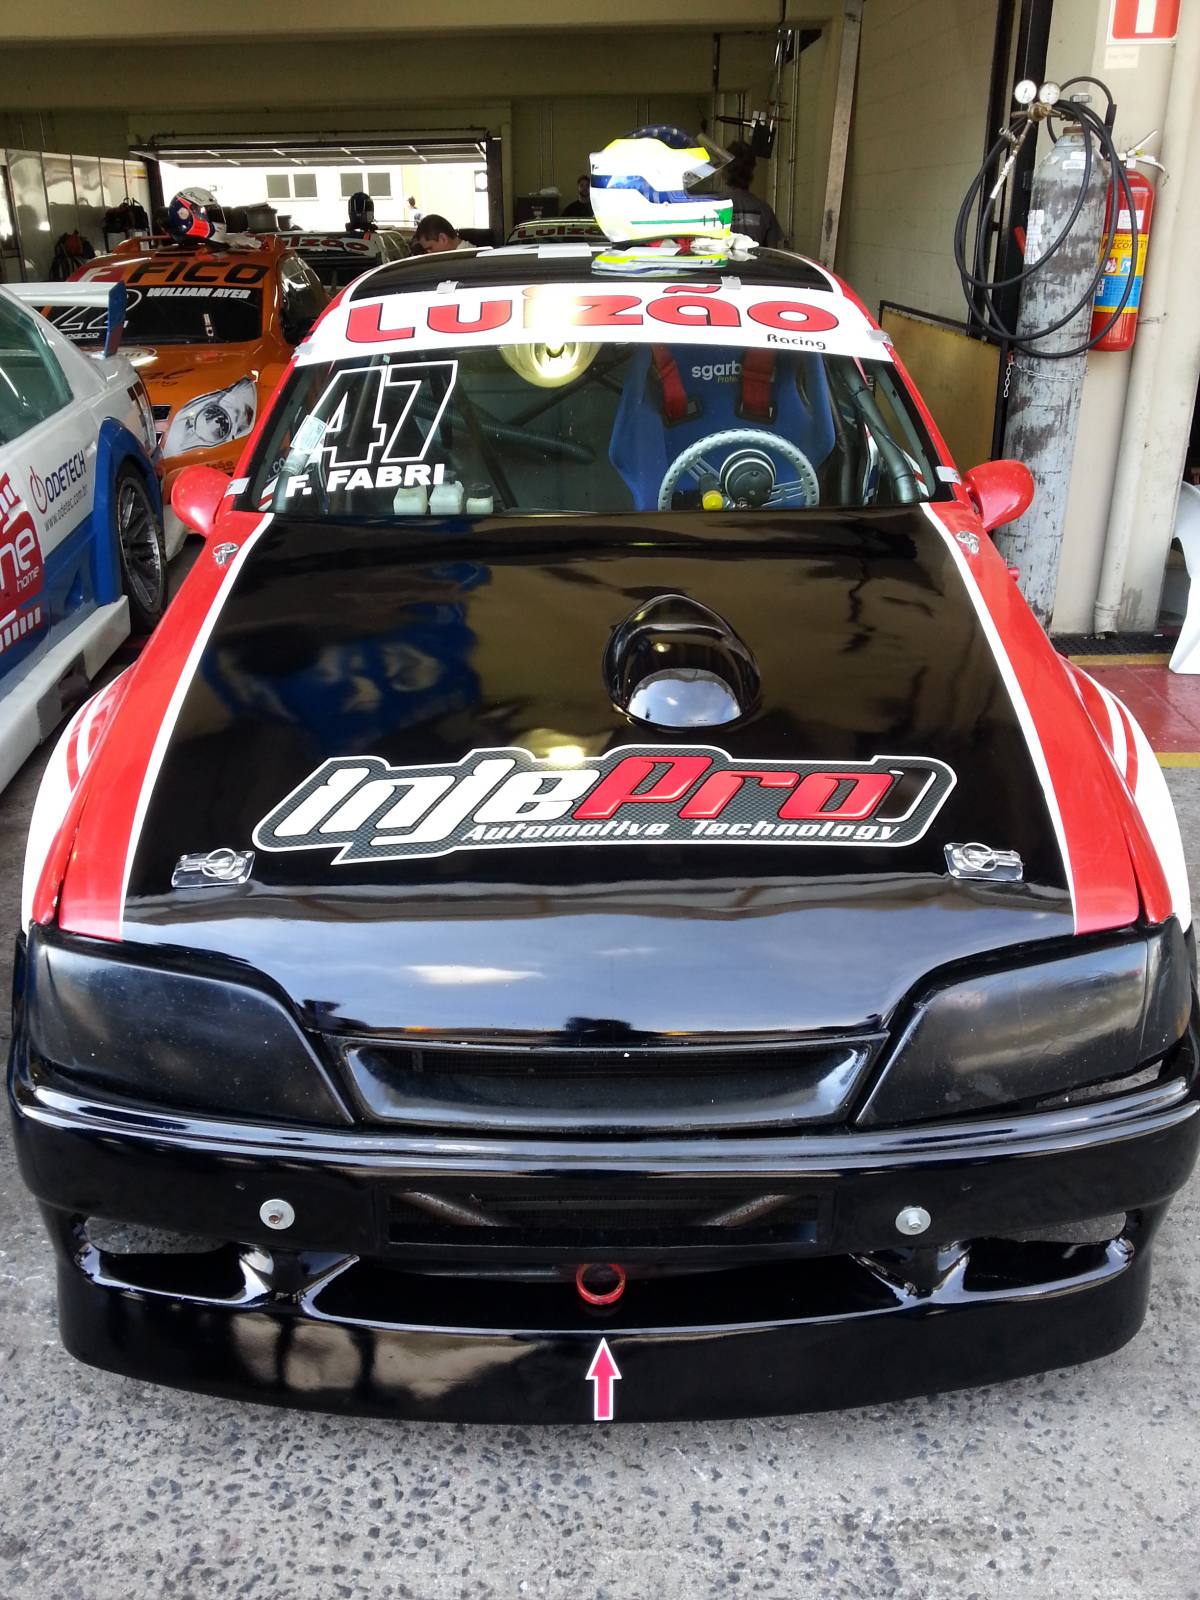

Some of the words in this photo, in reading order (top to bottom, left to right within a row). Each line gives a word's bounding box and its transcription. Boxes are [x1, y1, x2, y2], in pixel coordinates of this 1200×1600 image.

[127, 262, 270, 284] FICO
[346, 284, 840, 344] Luizão
[767, 333, 826, 350] Racing
[691, 359, 742, 380] sgarb
[294, 360, 458, 467] 47
[45, 450, 86, 503] ODETECH
[285, 473, 313, 497] F.
[326, 463, 445, 492] FABRI
[16, 565, 40, 592] home
[461, 820, 671, 842] Automotive
[690, 819, 900, 841] Technology
